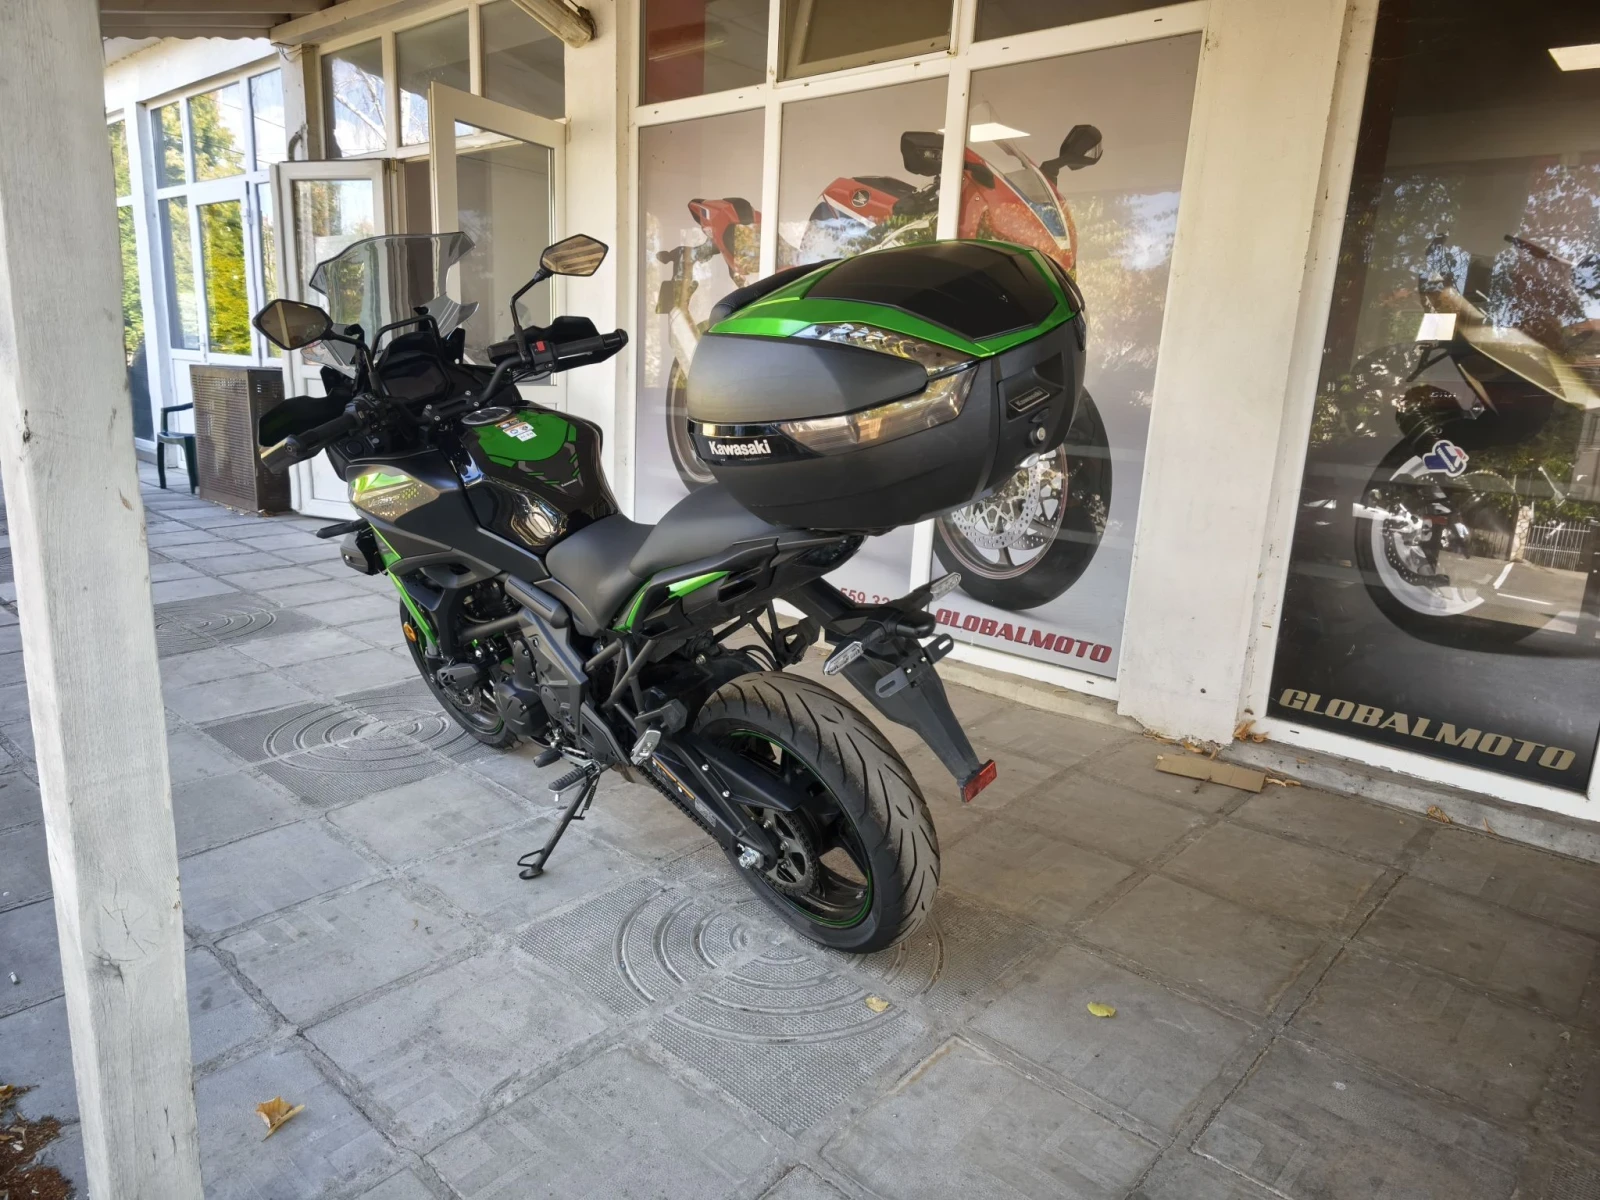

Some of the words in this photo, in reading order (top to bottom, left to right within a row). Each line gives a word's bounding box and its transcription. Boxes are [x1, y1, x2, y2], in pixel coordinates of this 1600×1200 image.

[708, 439, 772, 456] Kawasaki
[935, 608, 1113, 663] GLOBALMOTO
[1278, 688, 1576, 771] GLOBALMOTO
